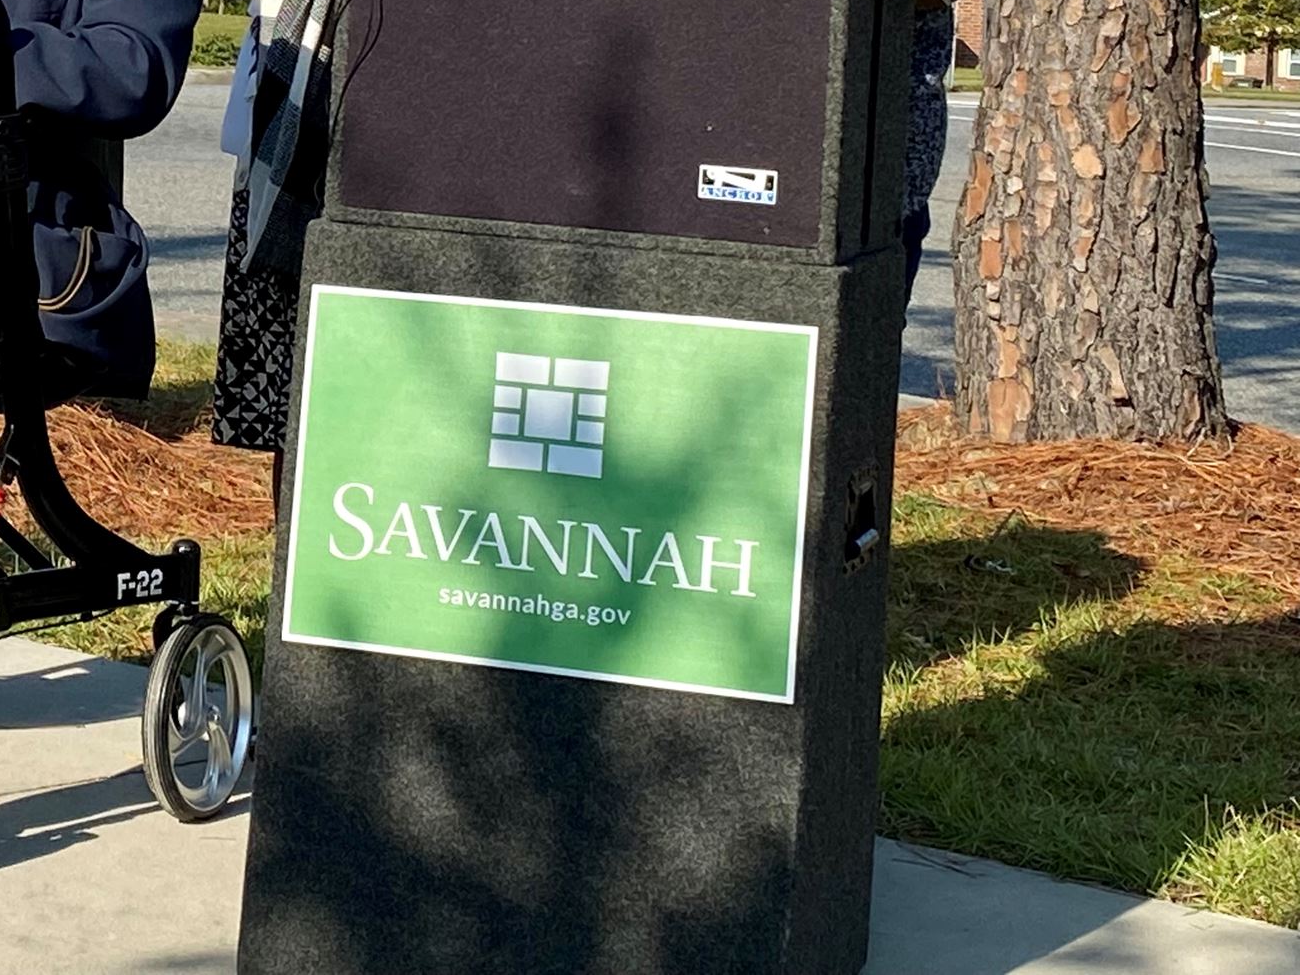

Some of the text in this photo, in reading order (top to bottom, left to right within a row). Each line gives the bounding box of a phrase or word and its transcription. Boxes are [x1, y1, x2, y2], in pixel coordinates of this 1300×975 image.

[328, 482, 759, 598] SAVANNAH
[117, 568, 163, 600] F-22
[438, 586, 631, 626] savannahga.gov
